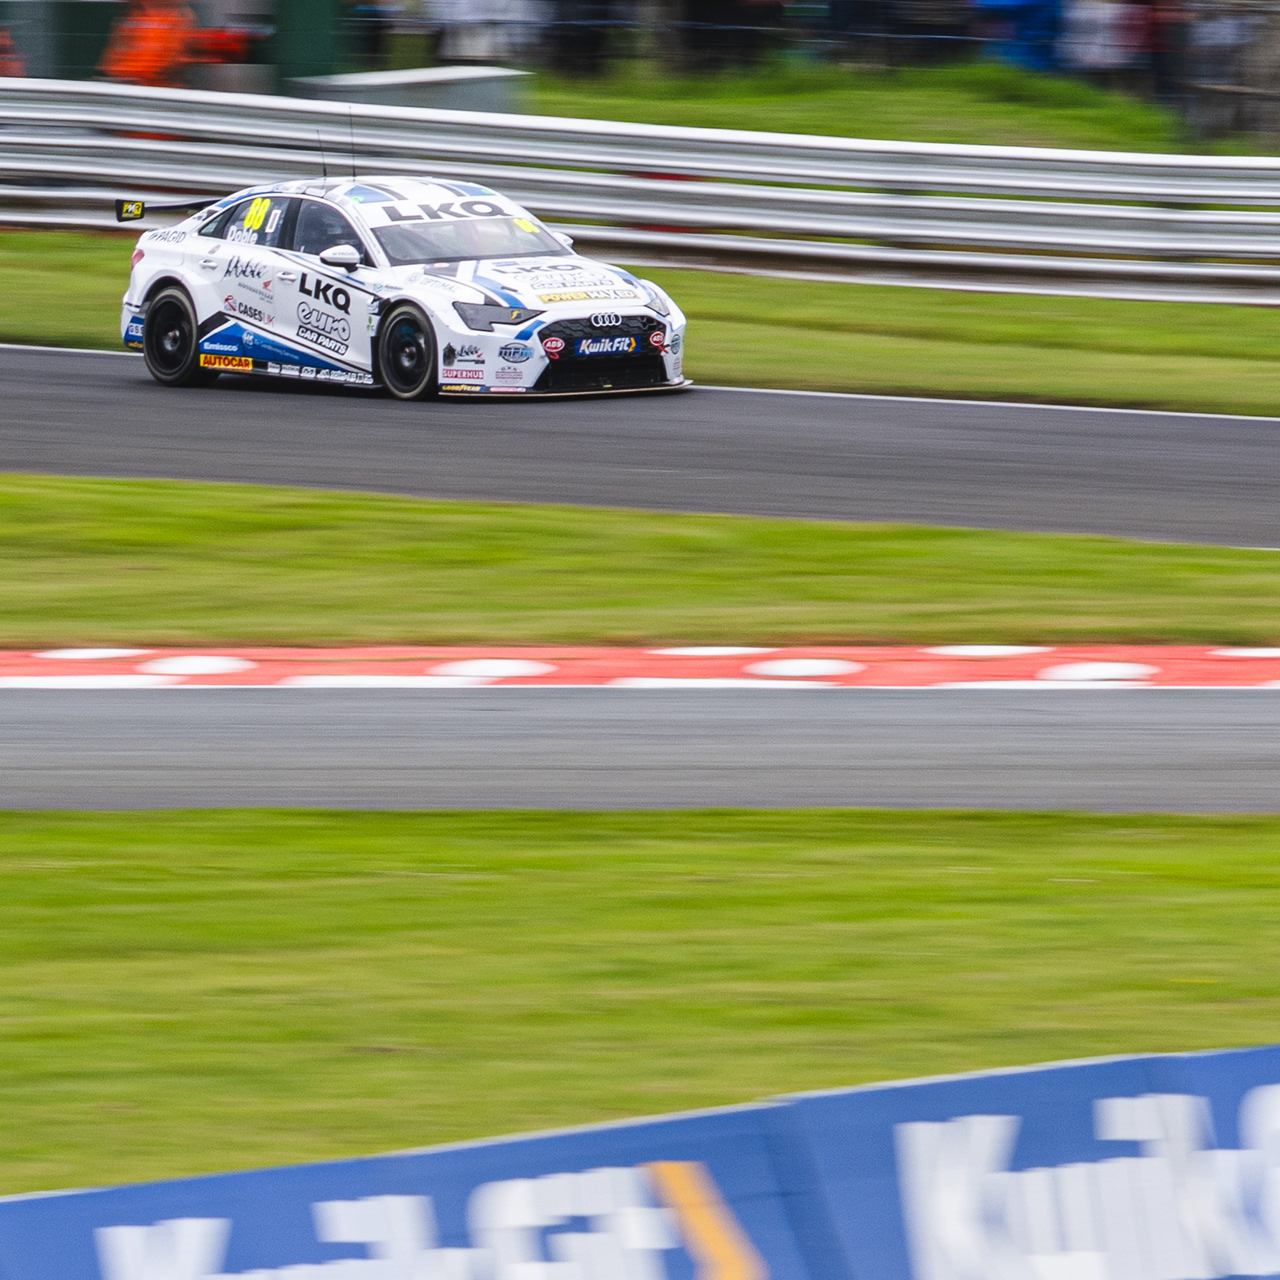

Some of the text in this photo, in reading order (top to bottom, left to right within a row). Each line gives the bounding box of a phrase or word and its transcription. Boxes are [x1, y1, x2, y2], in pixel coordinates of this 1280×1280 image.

[243, 197, 270, 230] 88
[381, 201, 513, 221] LKQ
[227, 225, 258, 244] Doble
[298, 272, 351, 315] LKQ
[296, 301, 351, 341] euro
[299, 327, 317, 342] CAR
[318, 335, 347, 354] PARTS
[579, 337, 630, 355] KwikFit
[203, 356, 250, 369] AUTOCAR
[443, 369, 484, 379] SUPERHUB
